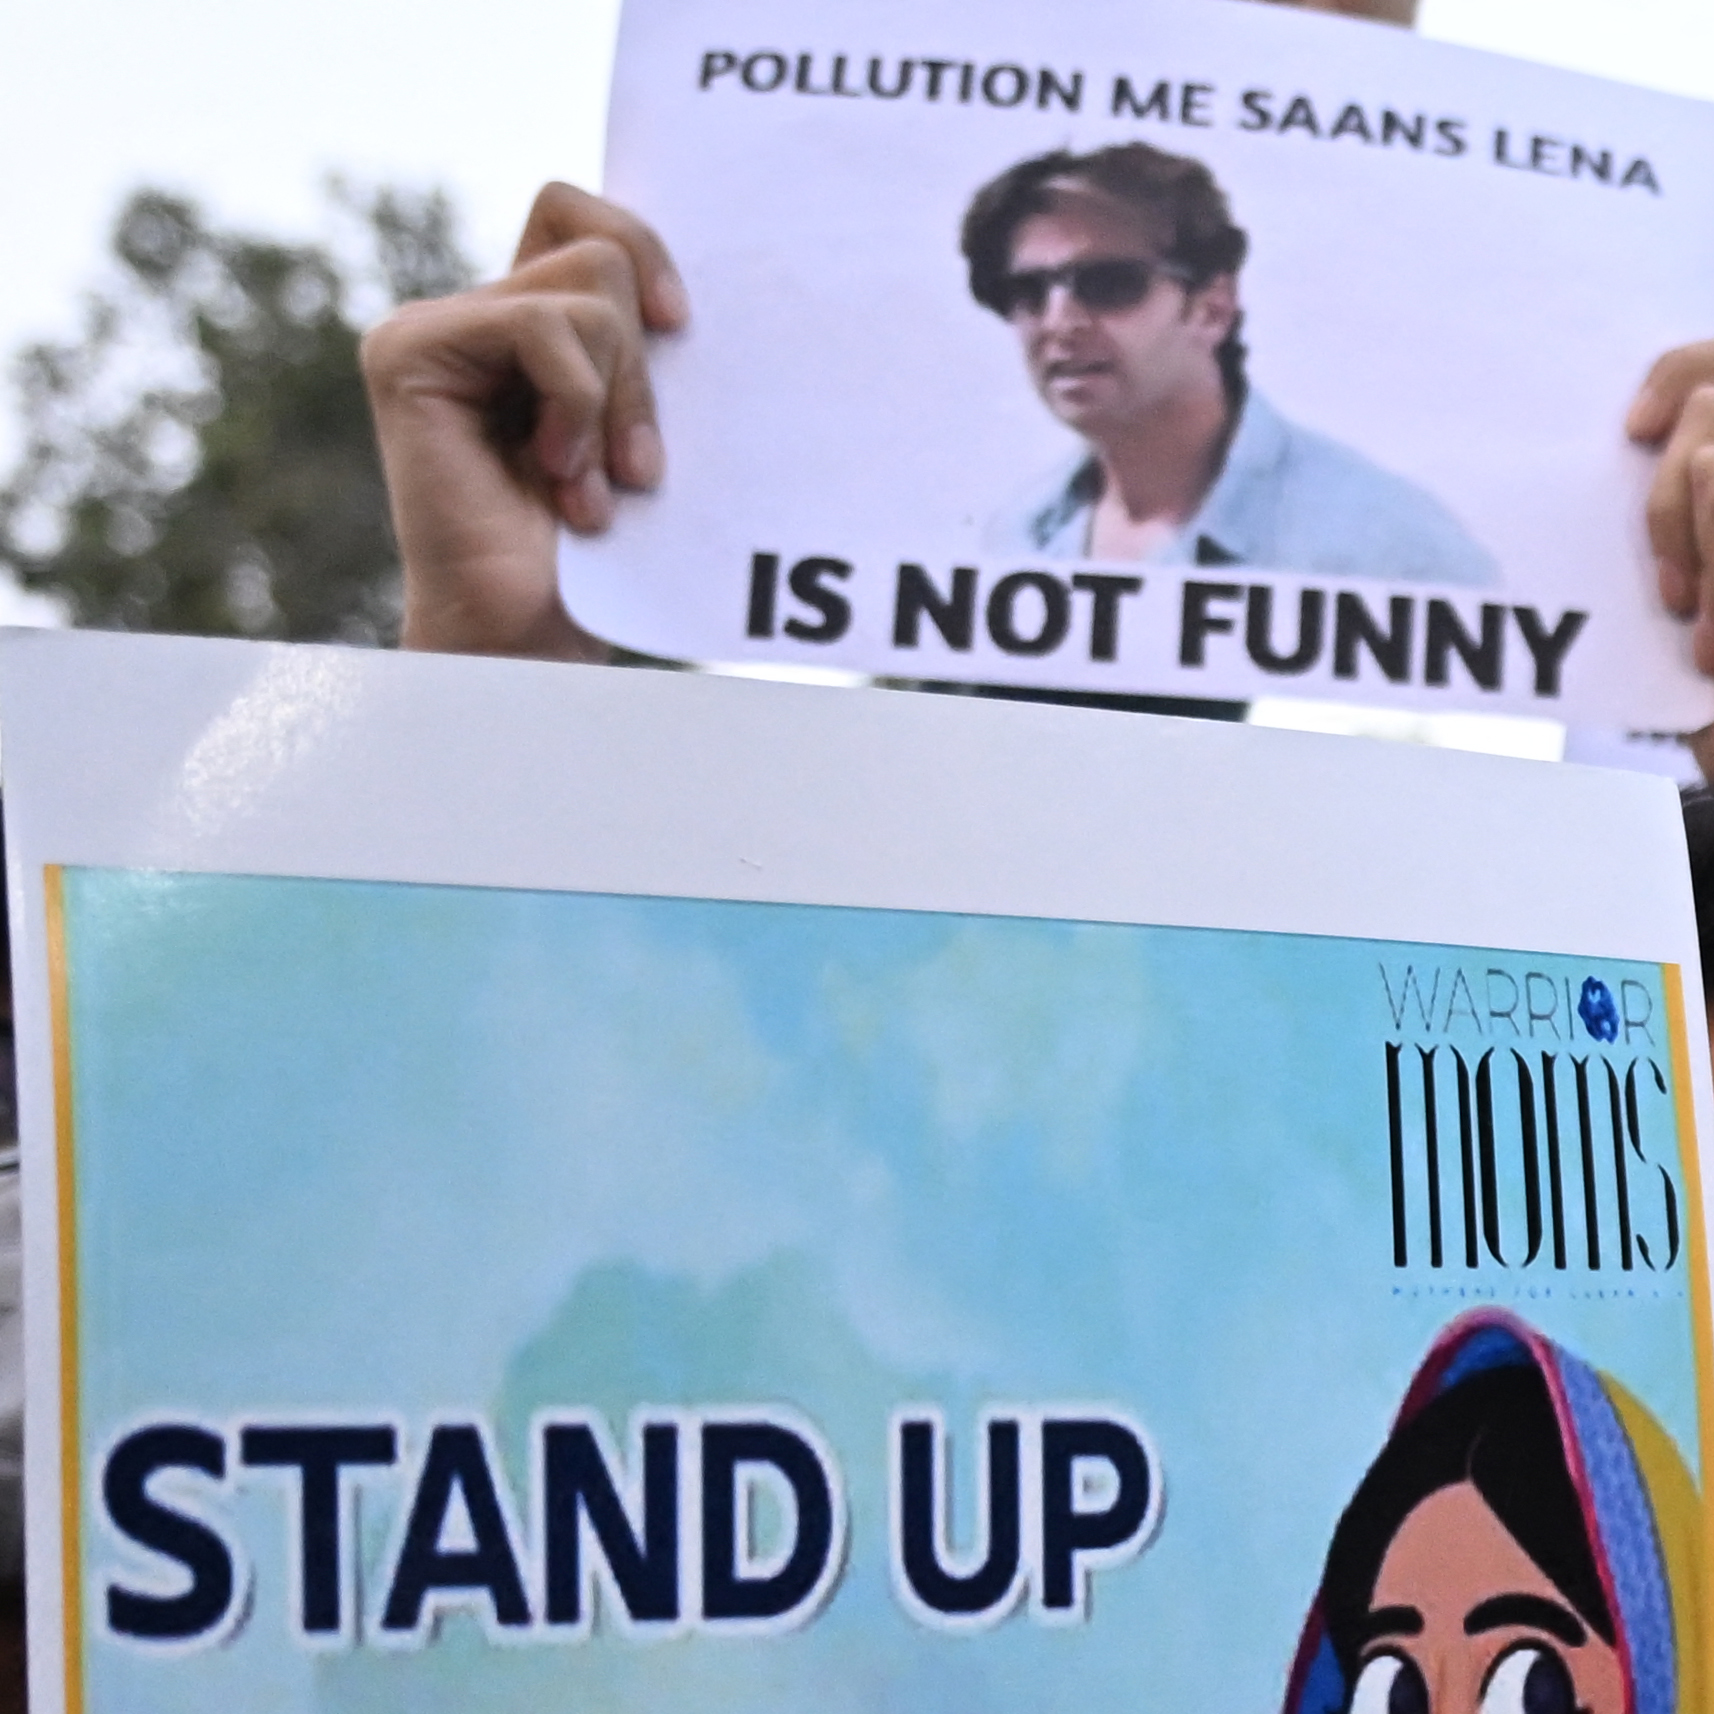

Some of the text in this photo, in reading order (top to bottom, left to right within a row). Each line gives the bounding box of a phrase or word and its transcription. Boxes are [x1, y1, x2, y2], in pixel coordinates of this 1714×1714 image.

[699, 49, 1664, 196] POLLUTION ME SAANS LENA
[744, 551, 1590, 699] IS NOT FUNNY
[101, 1417, 1154, 1640] STAND UP
